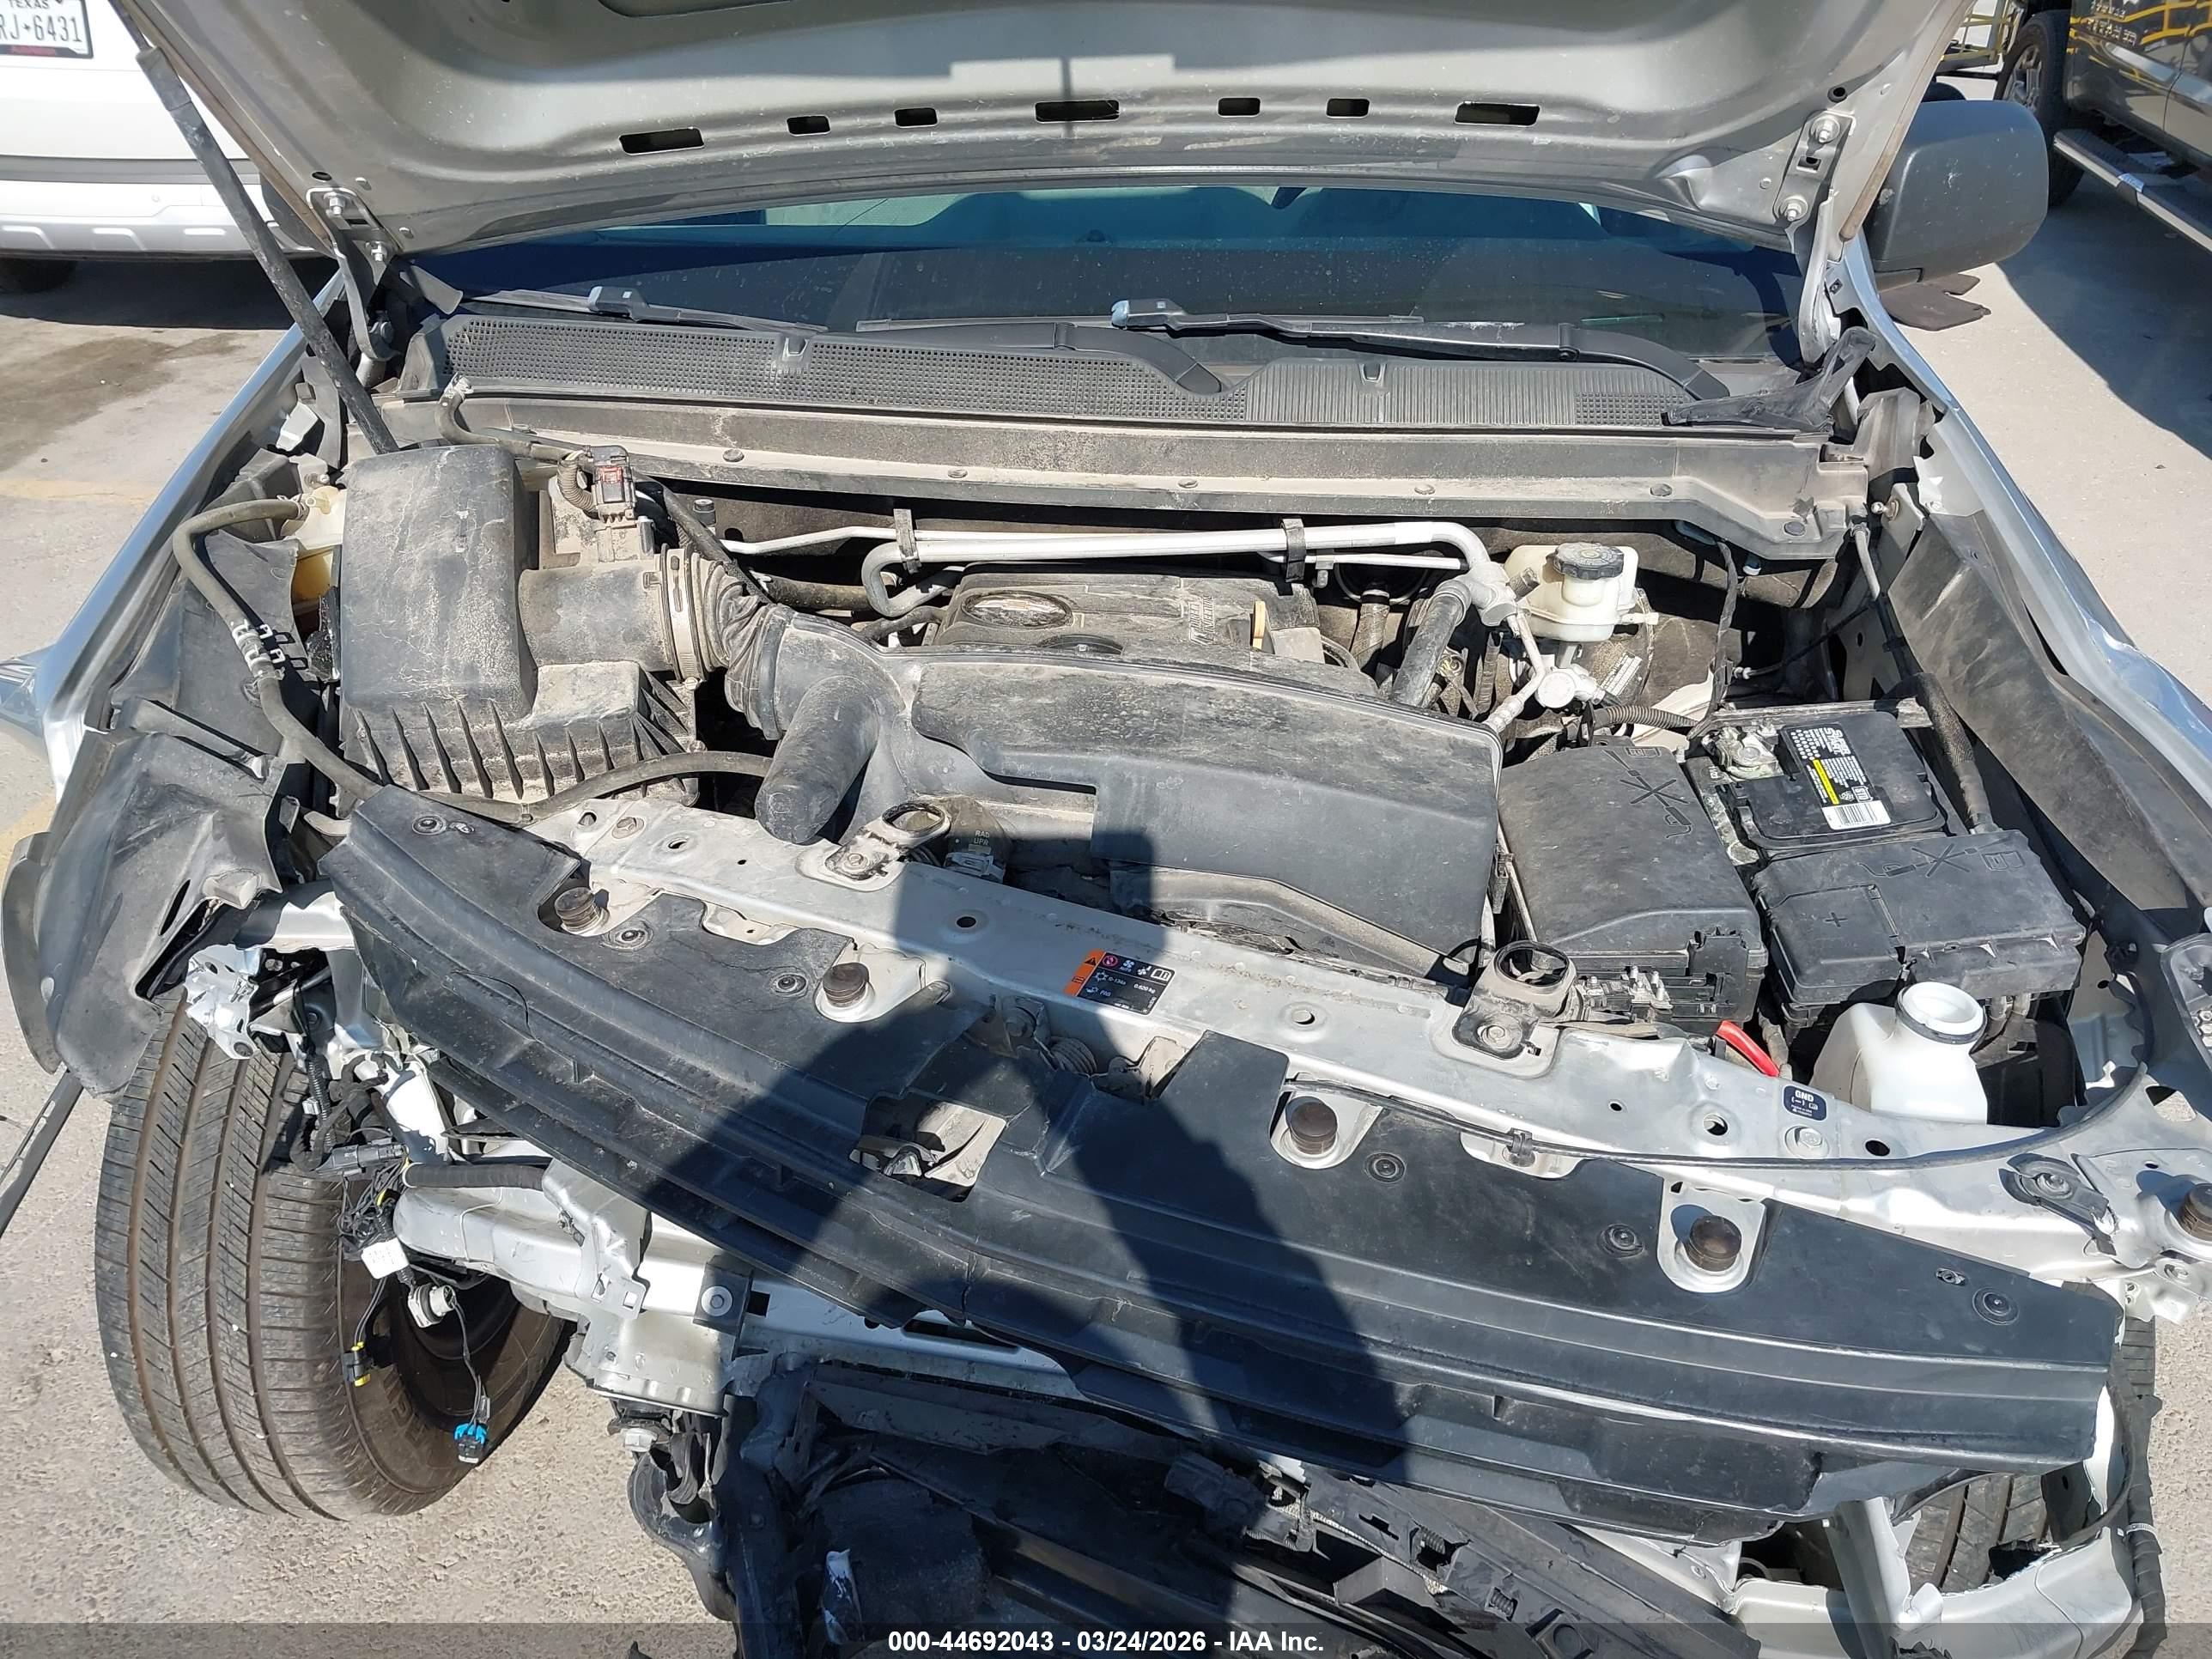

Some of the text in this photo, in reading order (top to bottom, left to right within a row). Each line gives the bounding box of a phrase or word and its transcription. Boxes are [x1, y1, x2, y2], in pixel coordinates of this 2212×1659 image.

[9, 0, 49, 9] TEXAS
[975, 830, 989, 838] RAD
[1795, 1090, 1814, 1102] GND
